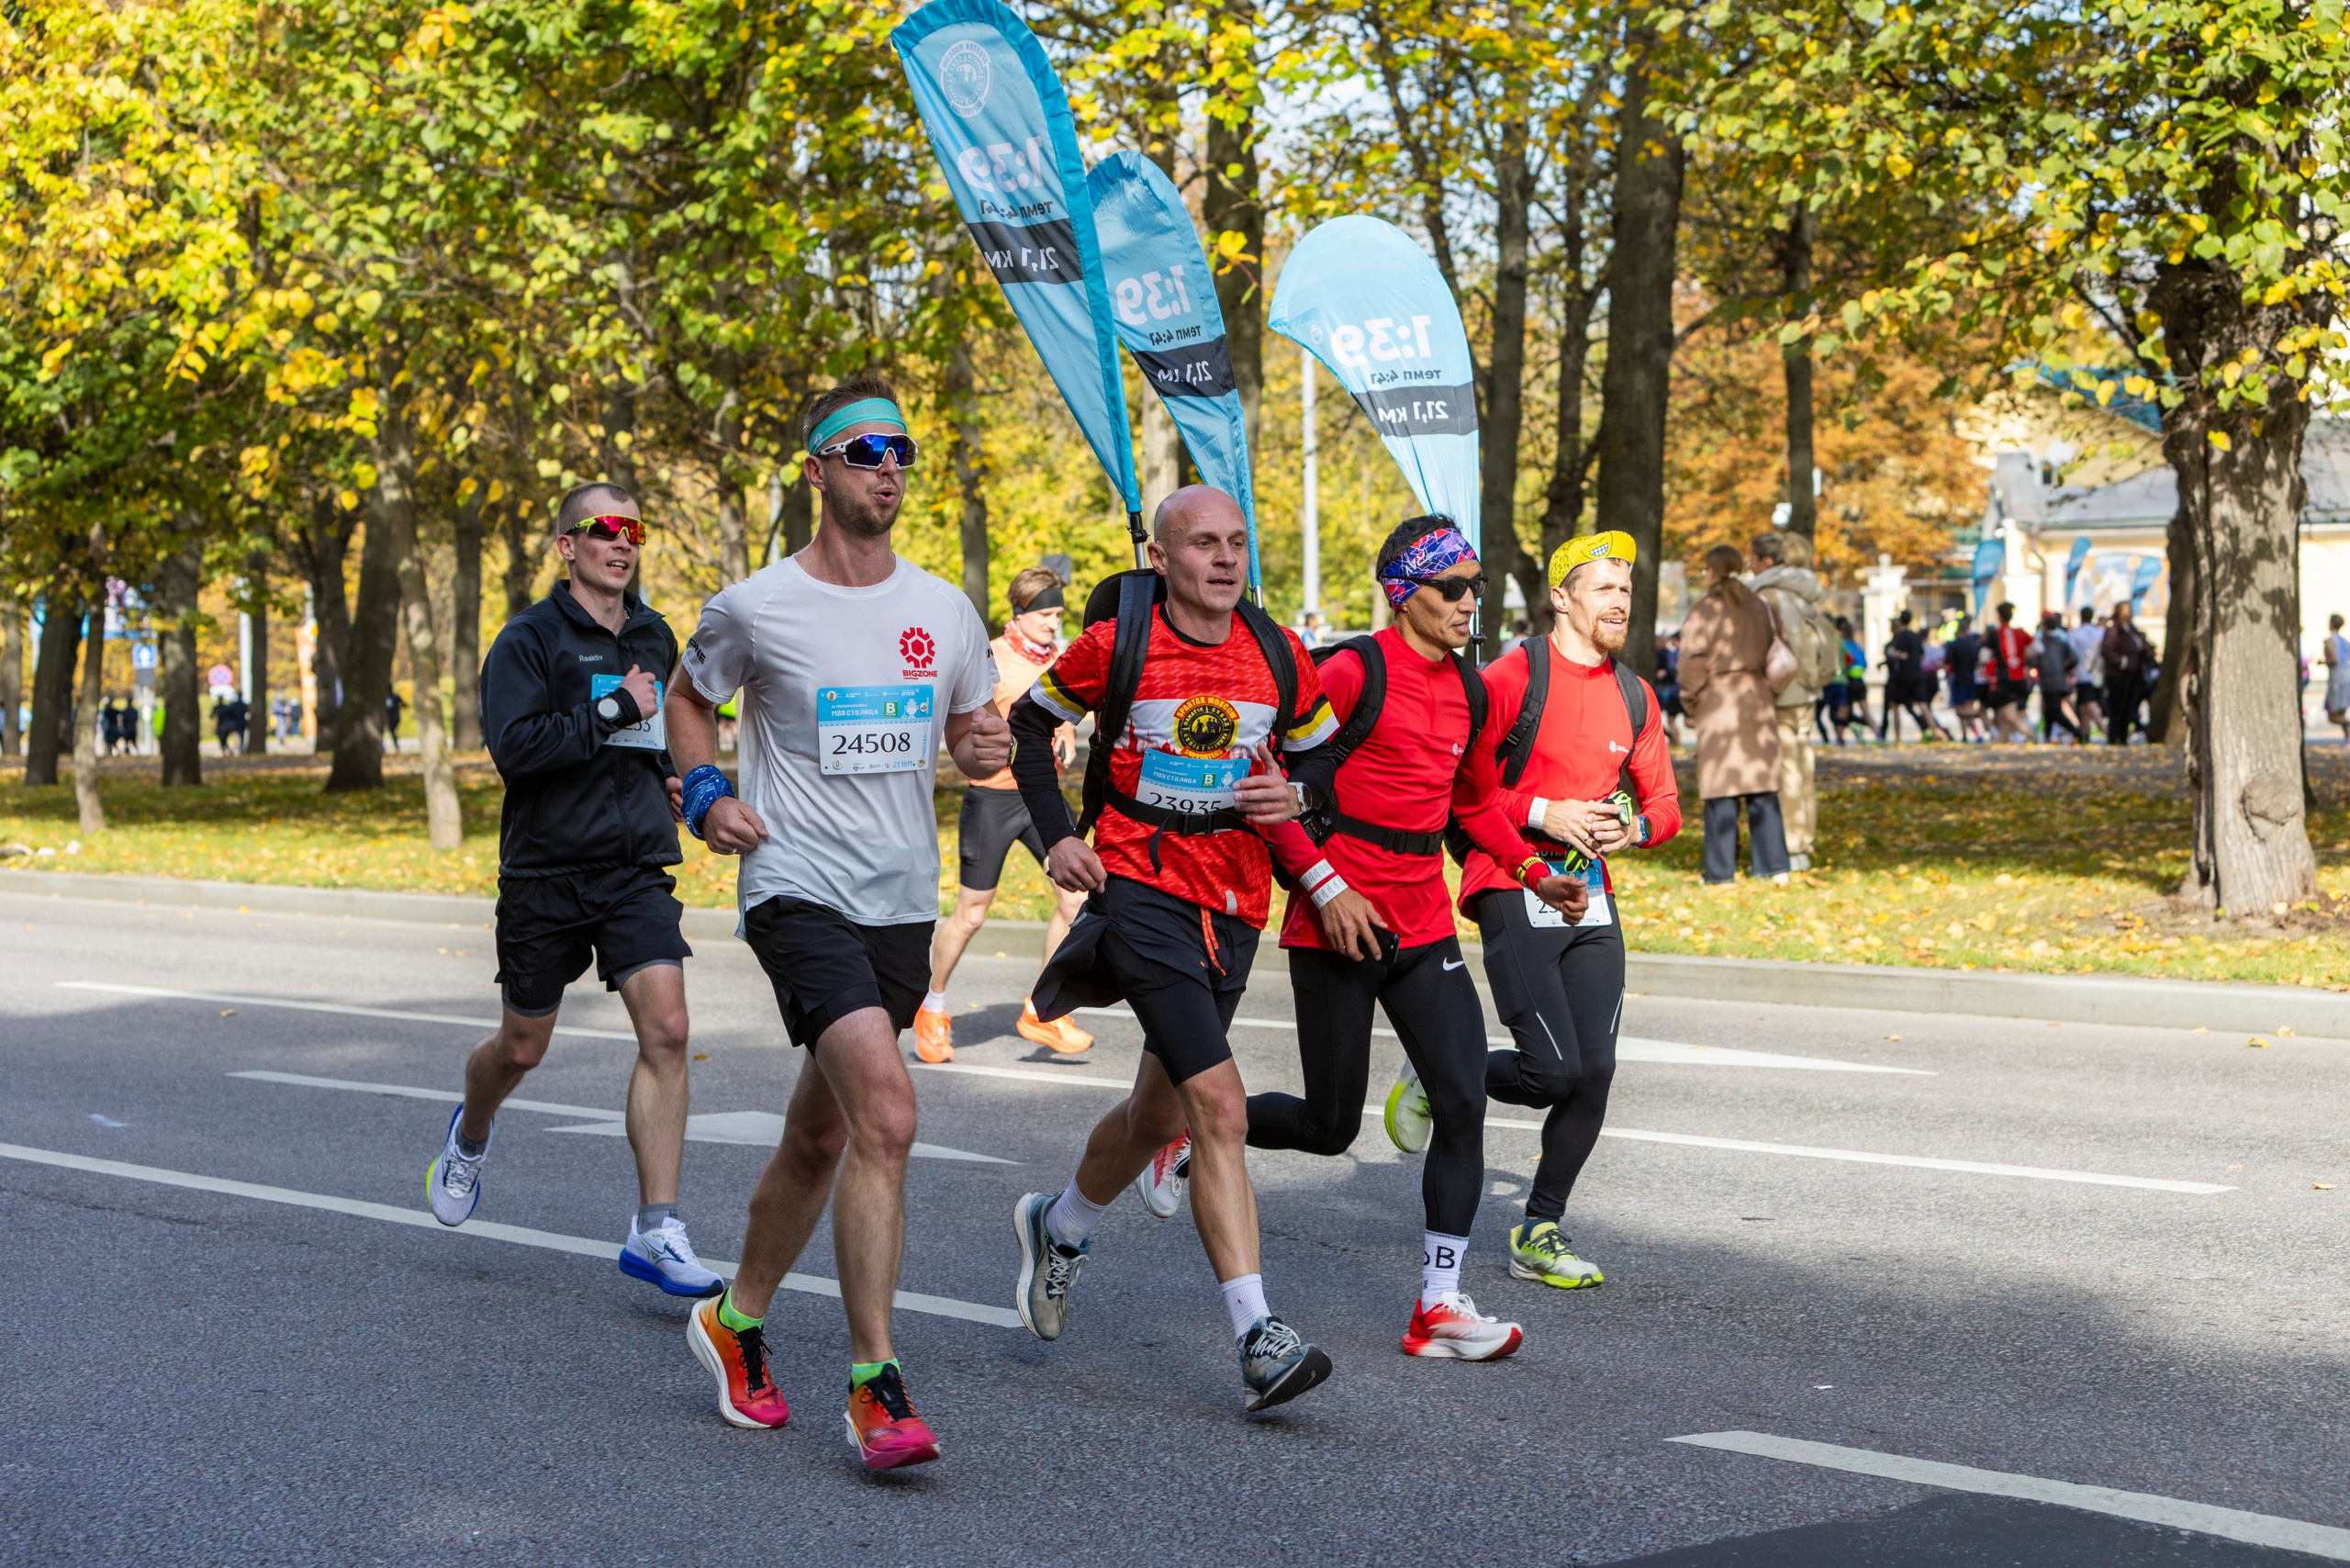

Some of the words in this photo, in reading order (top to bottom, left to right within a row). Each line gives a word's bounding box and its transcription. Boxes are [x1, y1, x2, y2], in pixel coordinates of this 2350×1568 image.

[1176, 697, 1205, 718] SPARTAK
[1207, 697, 1237, 719] MOSCOW
[833, 732, 911, 755] 24508
[1183, 749, 1224, 759] SUPPORTERS
